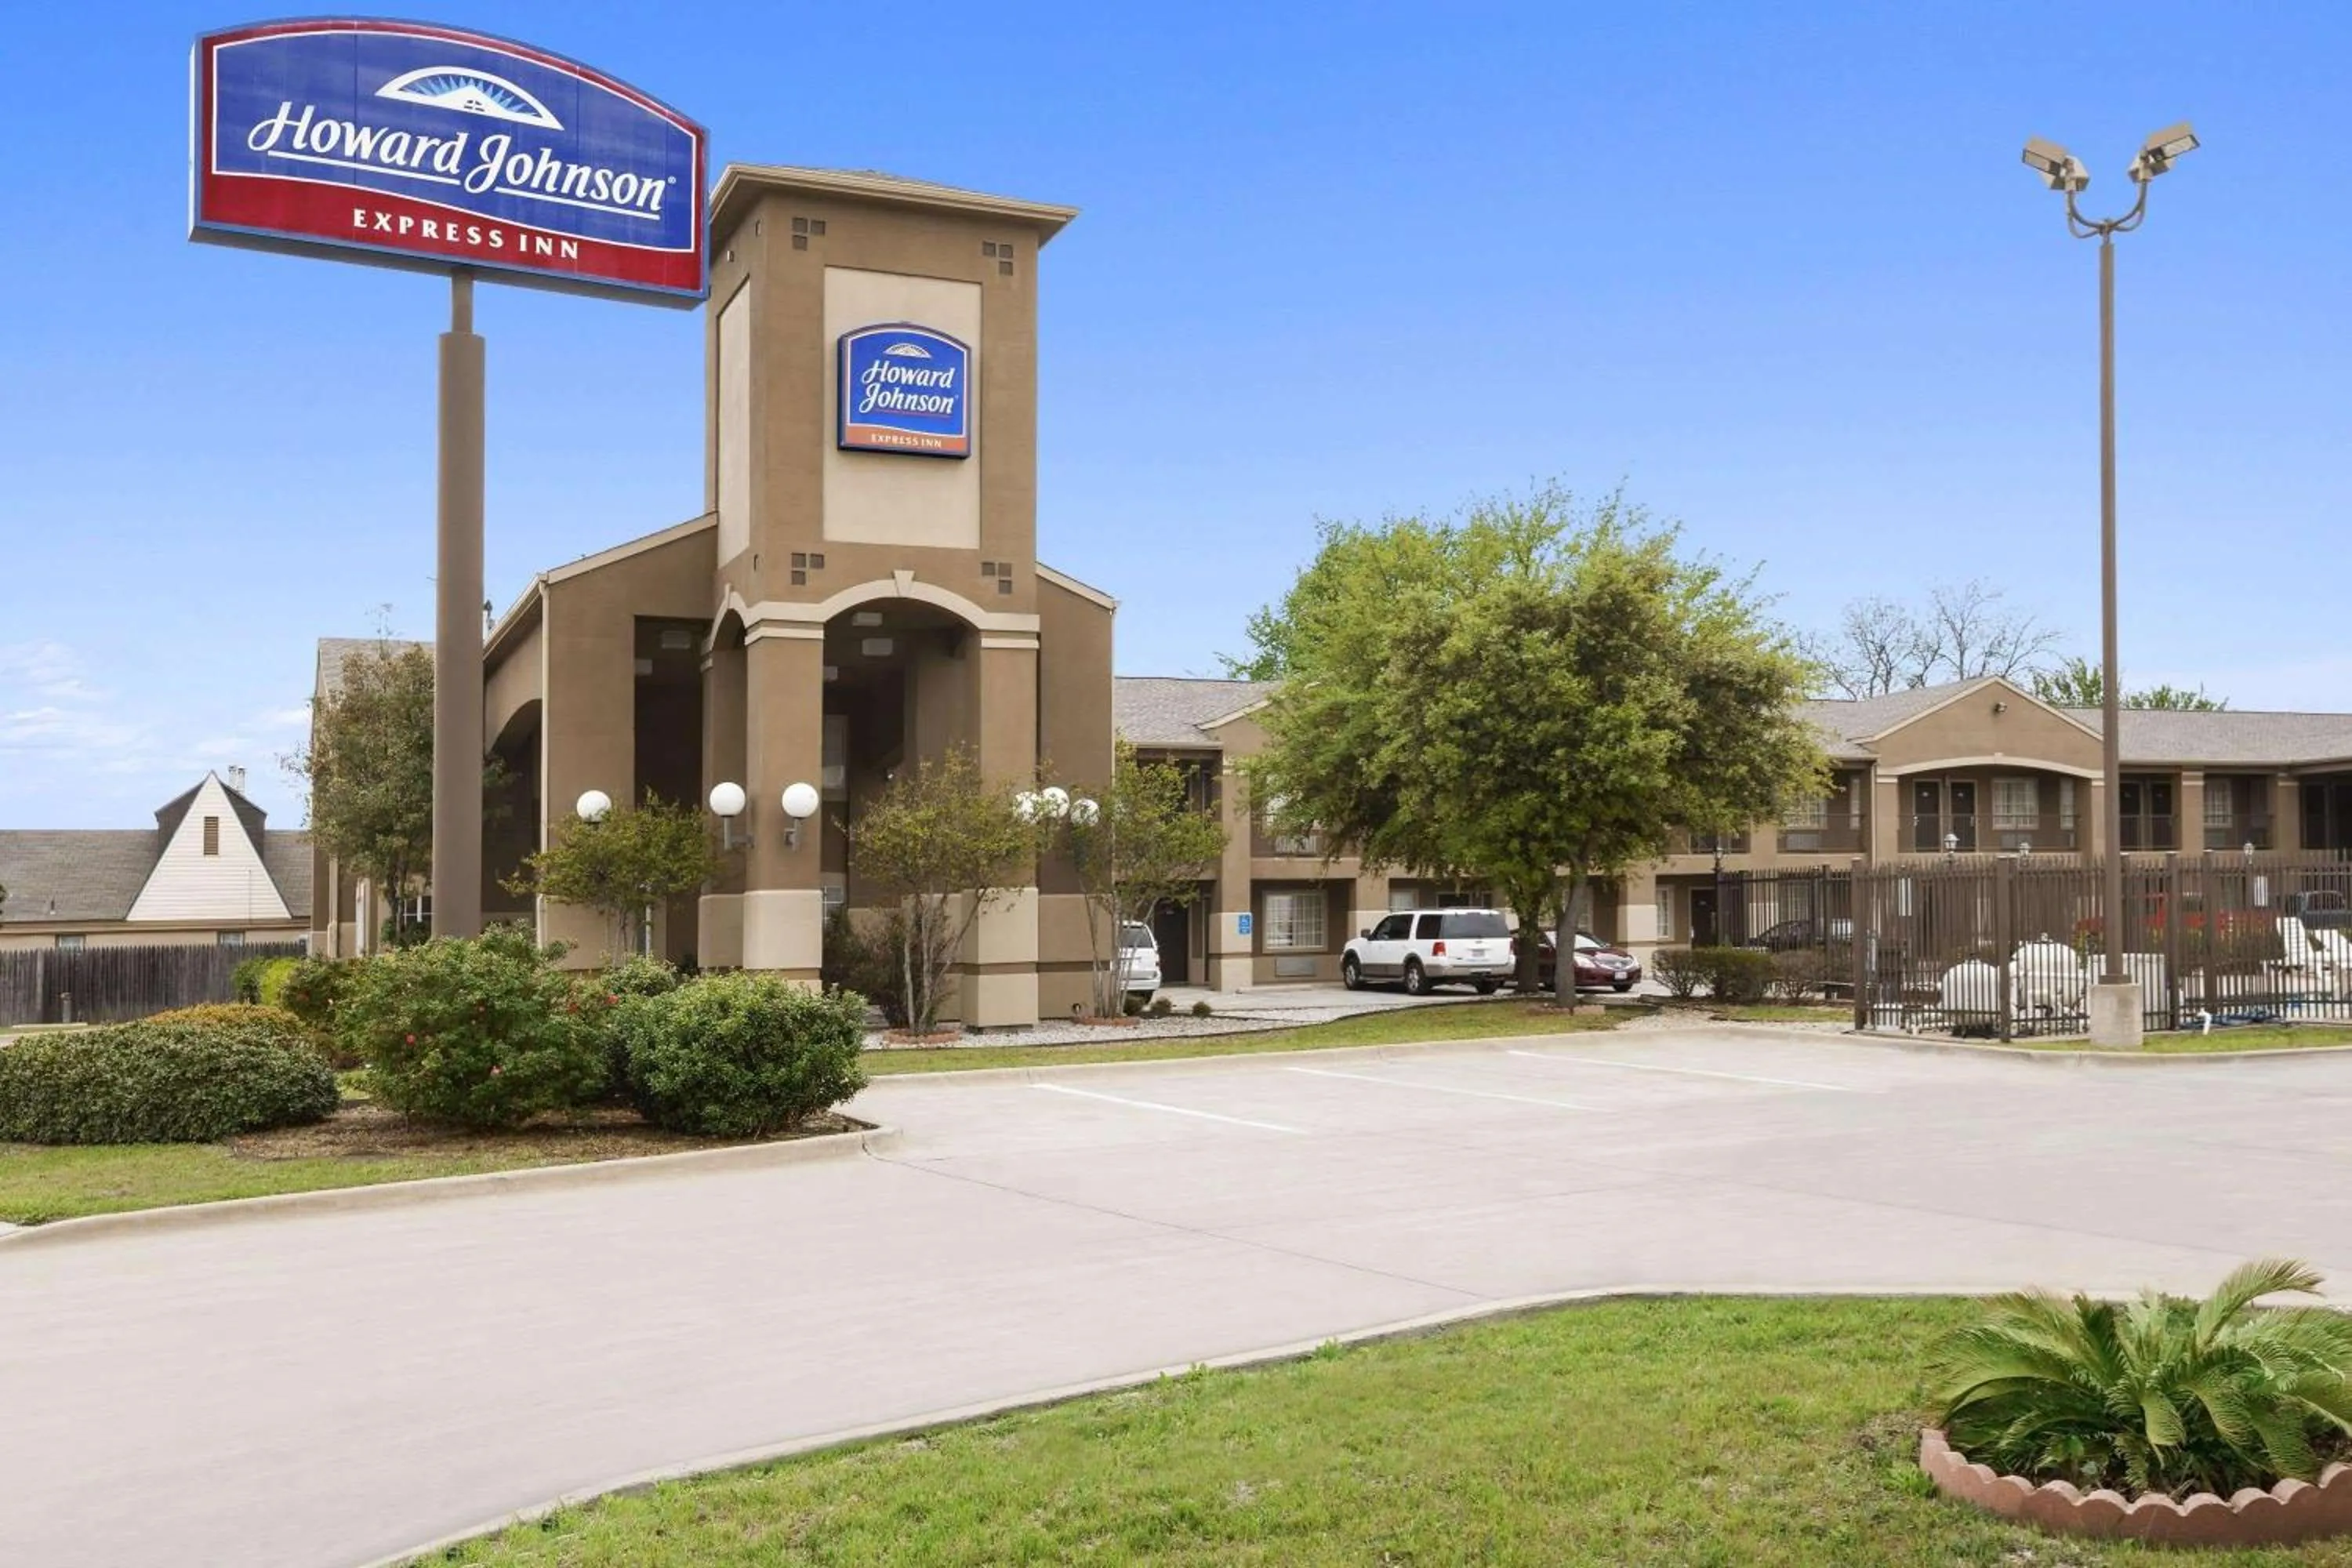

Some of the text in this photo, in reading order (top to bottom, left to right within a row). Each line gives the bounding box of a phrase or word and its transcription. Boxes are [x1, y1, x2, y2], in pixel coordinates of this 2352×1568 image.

[248, 101, 470, 174] Howard
[354, 208, 578, 260] EXPRESS INN
[862, 359, 956, 388] Howard
[859, 383, 954, 414] Johnson
[871, 434, 942, 448] EXPRESS INN
